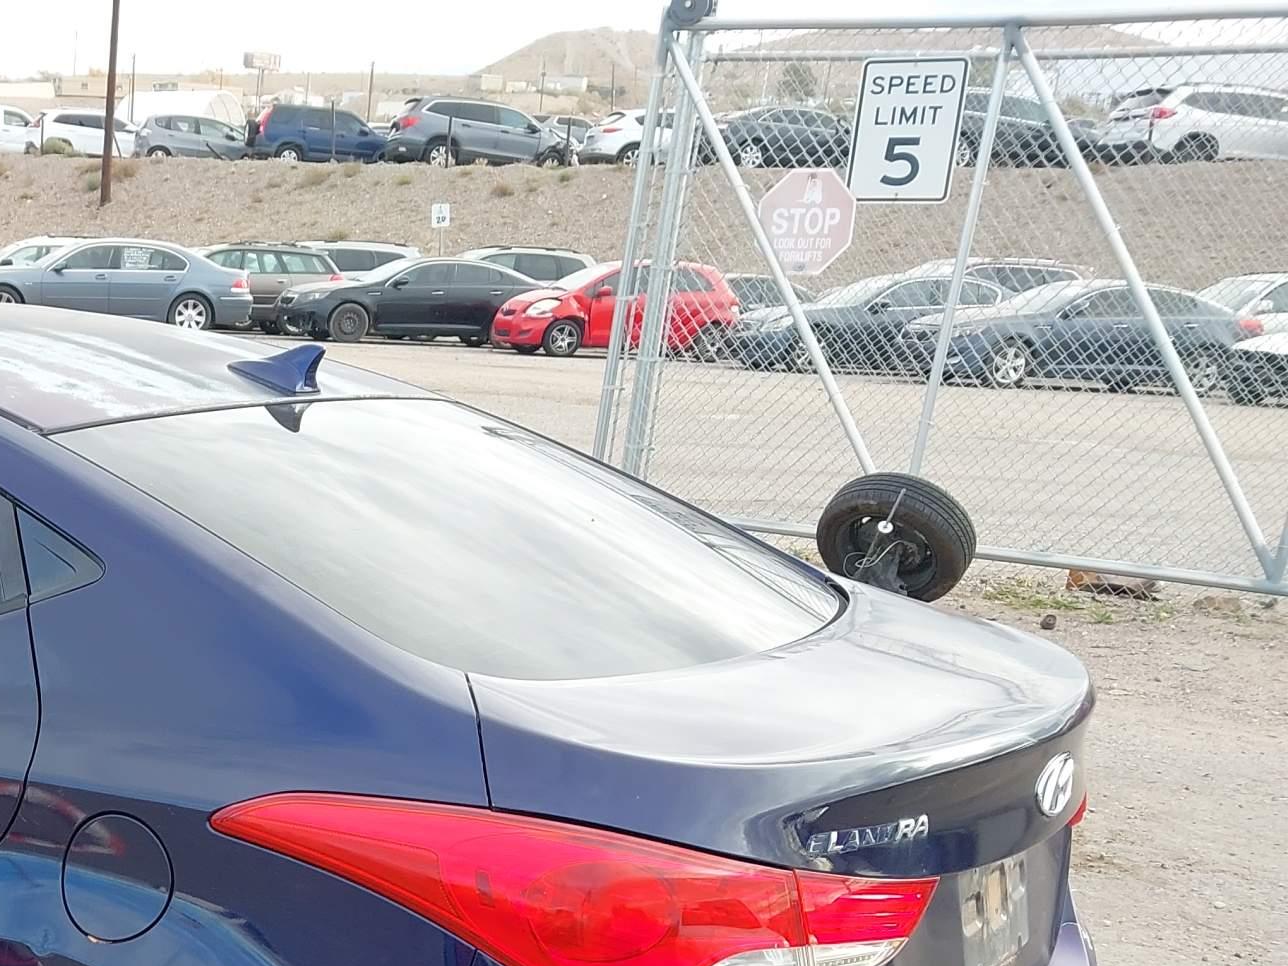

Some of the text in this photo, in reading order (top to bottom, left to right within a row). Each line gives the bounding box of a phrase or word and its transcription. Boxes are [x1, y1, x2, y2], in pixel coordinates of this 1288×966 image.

[870, 74, 956, 95] SPEED
[874, 105, 943, 126] LIMIT
[879, 136, 921, 186] 5
[772, 207, 841, 235] STOP
[773, 237, 832, 249] LOOK OUT FOR
